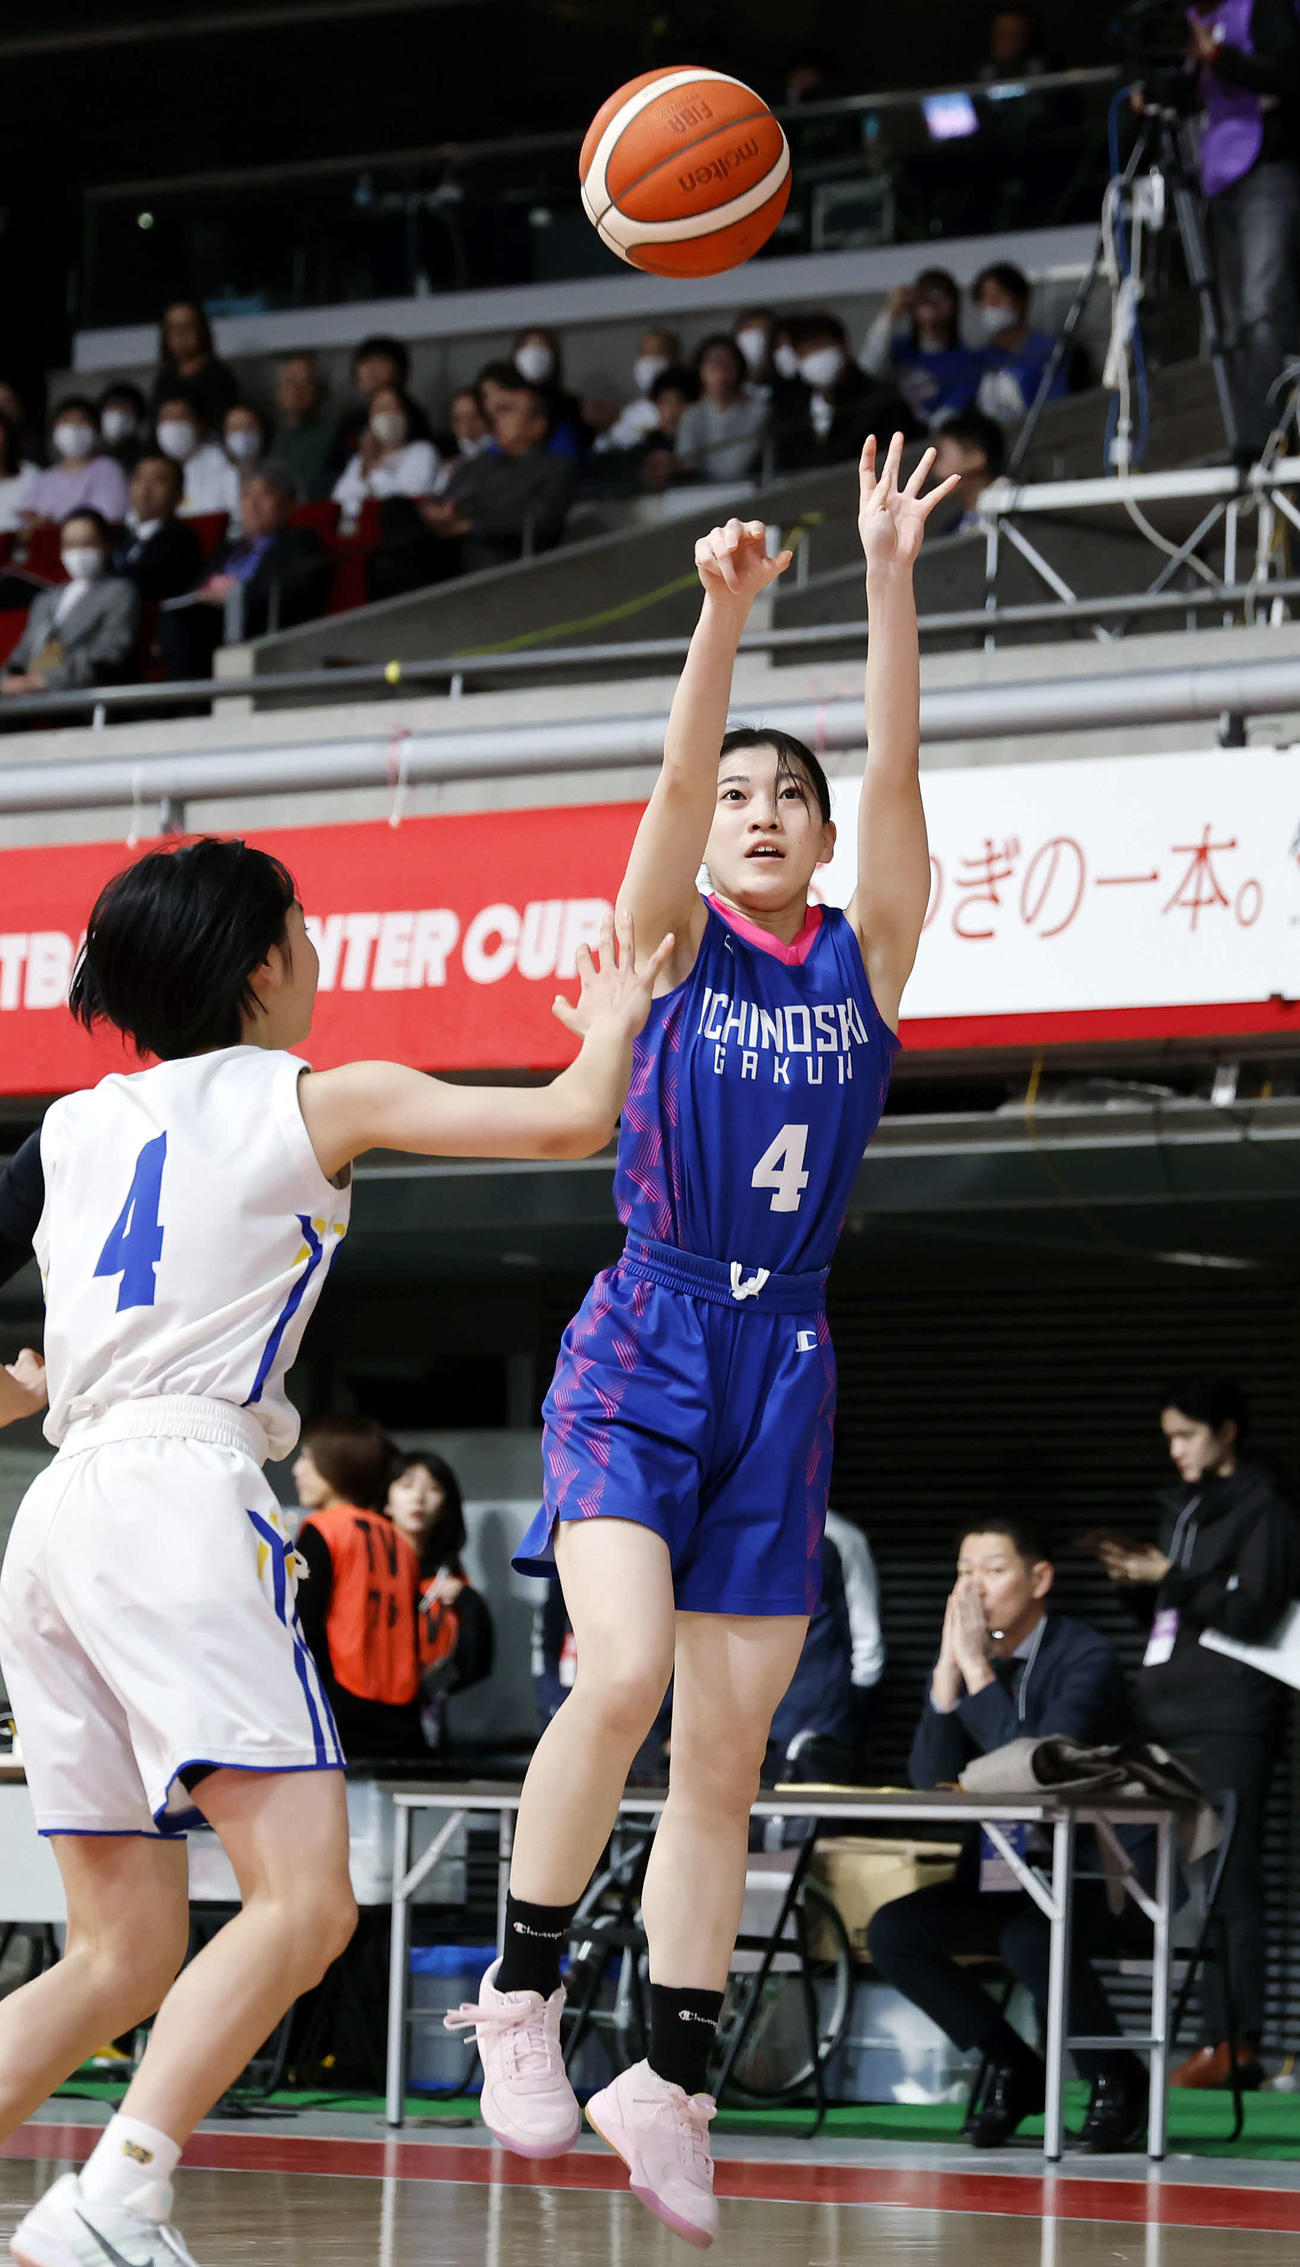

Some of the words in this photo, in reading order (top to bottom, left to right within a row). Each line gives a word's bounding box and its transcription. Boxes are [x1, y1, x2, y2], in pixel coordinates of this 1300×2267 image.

[668, 100, 715, 136] FIBA
[677, 138, 759, 193] molten
[925, 821, 1264, 941] ぎの一本。
[0, 930, 88, 1012] TB
[461, 897, 617, 985] CUP
[751, 1124, 810, 1213] 4
[92, 1129, 167, 1313] 4
